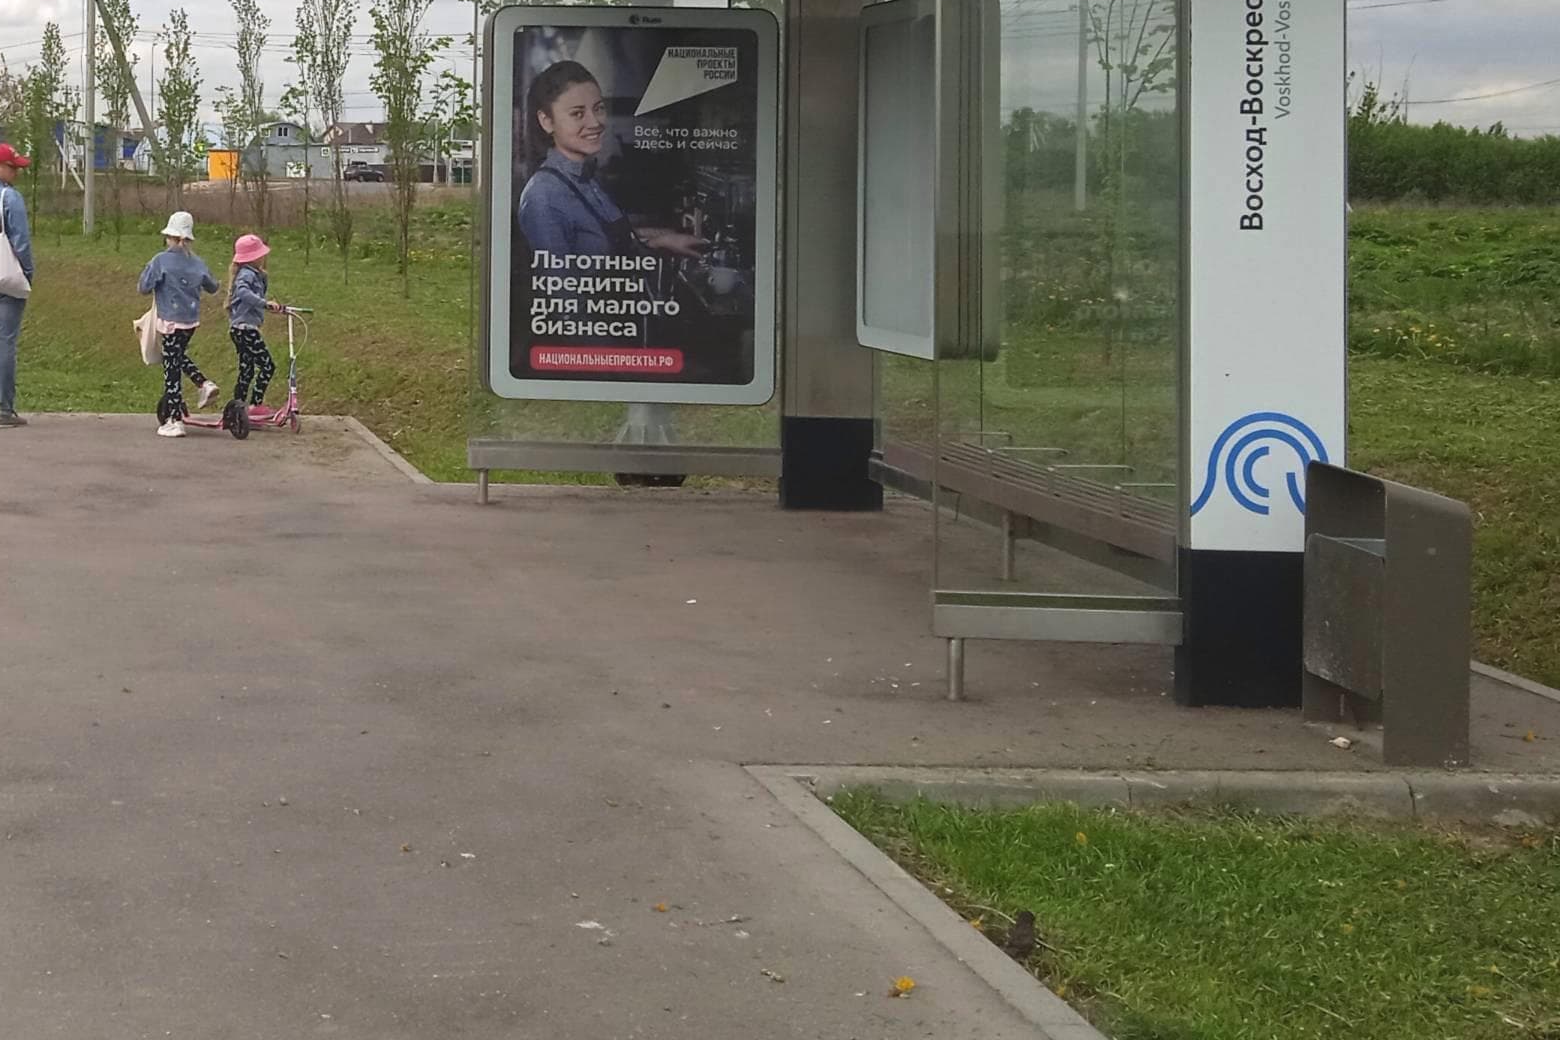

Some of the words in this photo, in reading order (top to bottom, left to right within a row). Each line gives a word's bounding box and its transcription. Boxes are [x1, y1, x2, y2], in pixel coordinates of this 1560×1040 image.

[668, 49, 736, 58] НАЦИОНАЛЬНЫЕ
[697, 59, 736, 69] ПРОЕКТЫ
[704, 70, 736, 79] РОССИИ
[666, 128, 689, 137] что
[693, 129, 738, 138] важно
[633, 140, 673, 150] здесь
[677, 141, 686, 149] и
[690, 139, 739, 150] сейчас
[530, 249, 657, 271] Льготные
[531, 275, 644, 296] кредиты
[530, 298, 578, 315] для
[586, 299, 680, 316] малого
[531, 315, 637, 337] бизнеса
[539, 353, 674, 367] НАЦИОНАЛЬНЫЕПРОЕКТЫ.РФ
